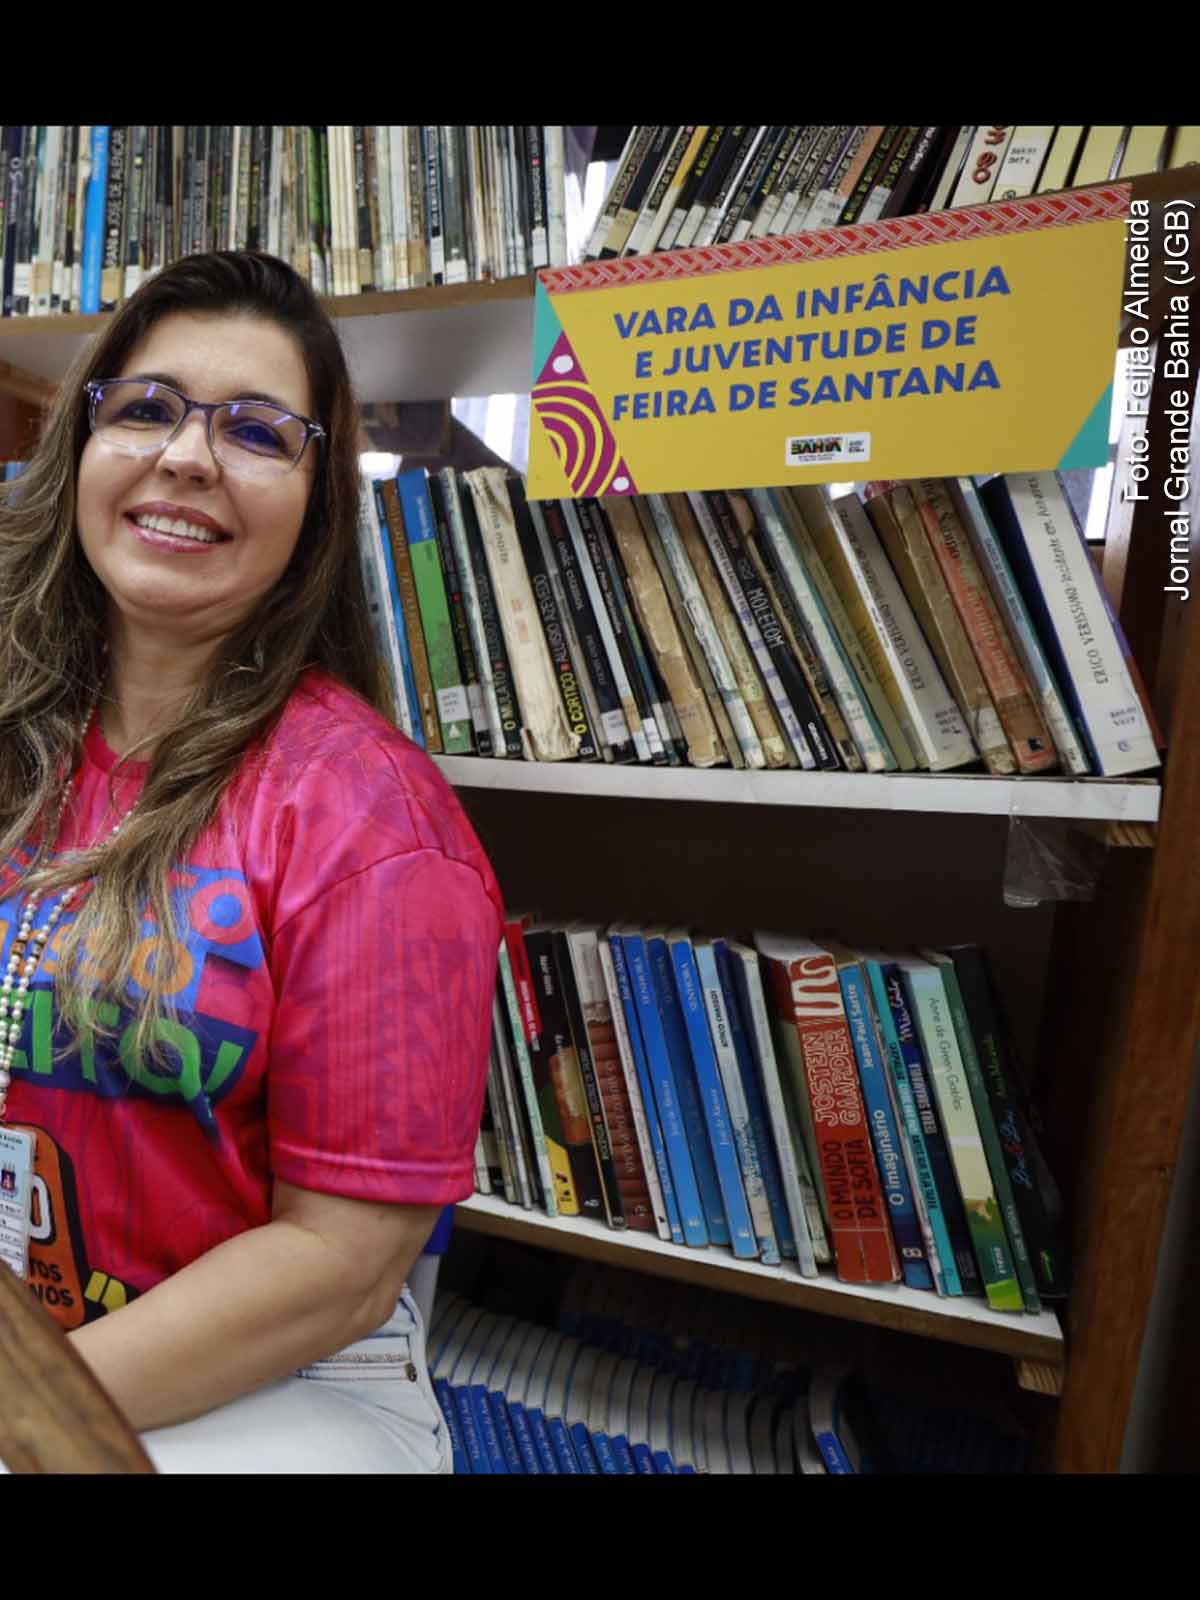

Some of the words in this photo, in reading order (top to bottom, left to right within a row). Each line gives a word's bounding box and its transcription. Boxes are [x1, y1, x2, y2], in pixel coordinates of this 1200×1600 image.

[615, 304, 715, 338] VARA
[729, 295, 782, 326] DA
[796, 266, 1010, 318] INFÂNCIA
[636, 351, 652, 378] E
[664, 324, 907, 376] JUVENTUDE
[922, 316, 977, 349] DE
[613, 387, 716, 421] FEIRA
[729, 380, 776, 411] DE
[790, 361, 1000, 406] SANTANA
[531, 572, 558, 622] AZEVEDO
[744, 585, 785, 649] MOLETOM
[1062, 585, 1095, 646] VERISSIMO
[1084, 647, 1109, 685] ERICO
[504, 720, 516, 730] O
[574, 723, 587, 734] O
[843, 982, 862, 1017] Sartre
[926, 995, 946, 1023] Anne
[850, 1017, 874, 1069] Jean-Paul
[933, 1022, 948, 1039] de
[935, 1038, 958, 1073] Green
[802, 1031, 840, 1128] JOSTEIN
[826, 1028, 862, 1127] GAARDER
[943, 1073, 968, 1112] Gables
[844, 1140, 873, 1191] SOFIA
[873, 1109, 901, 1189] imaginário
[822, 1141, 852, 1208] MUNDO
[834, 1208, 854, 1221] O
[853, 1195, 879, 1221] DE
[889, 1193, 905, 1207] O
